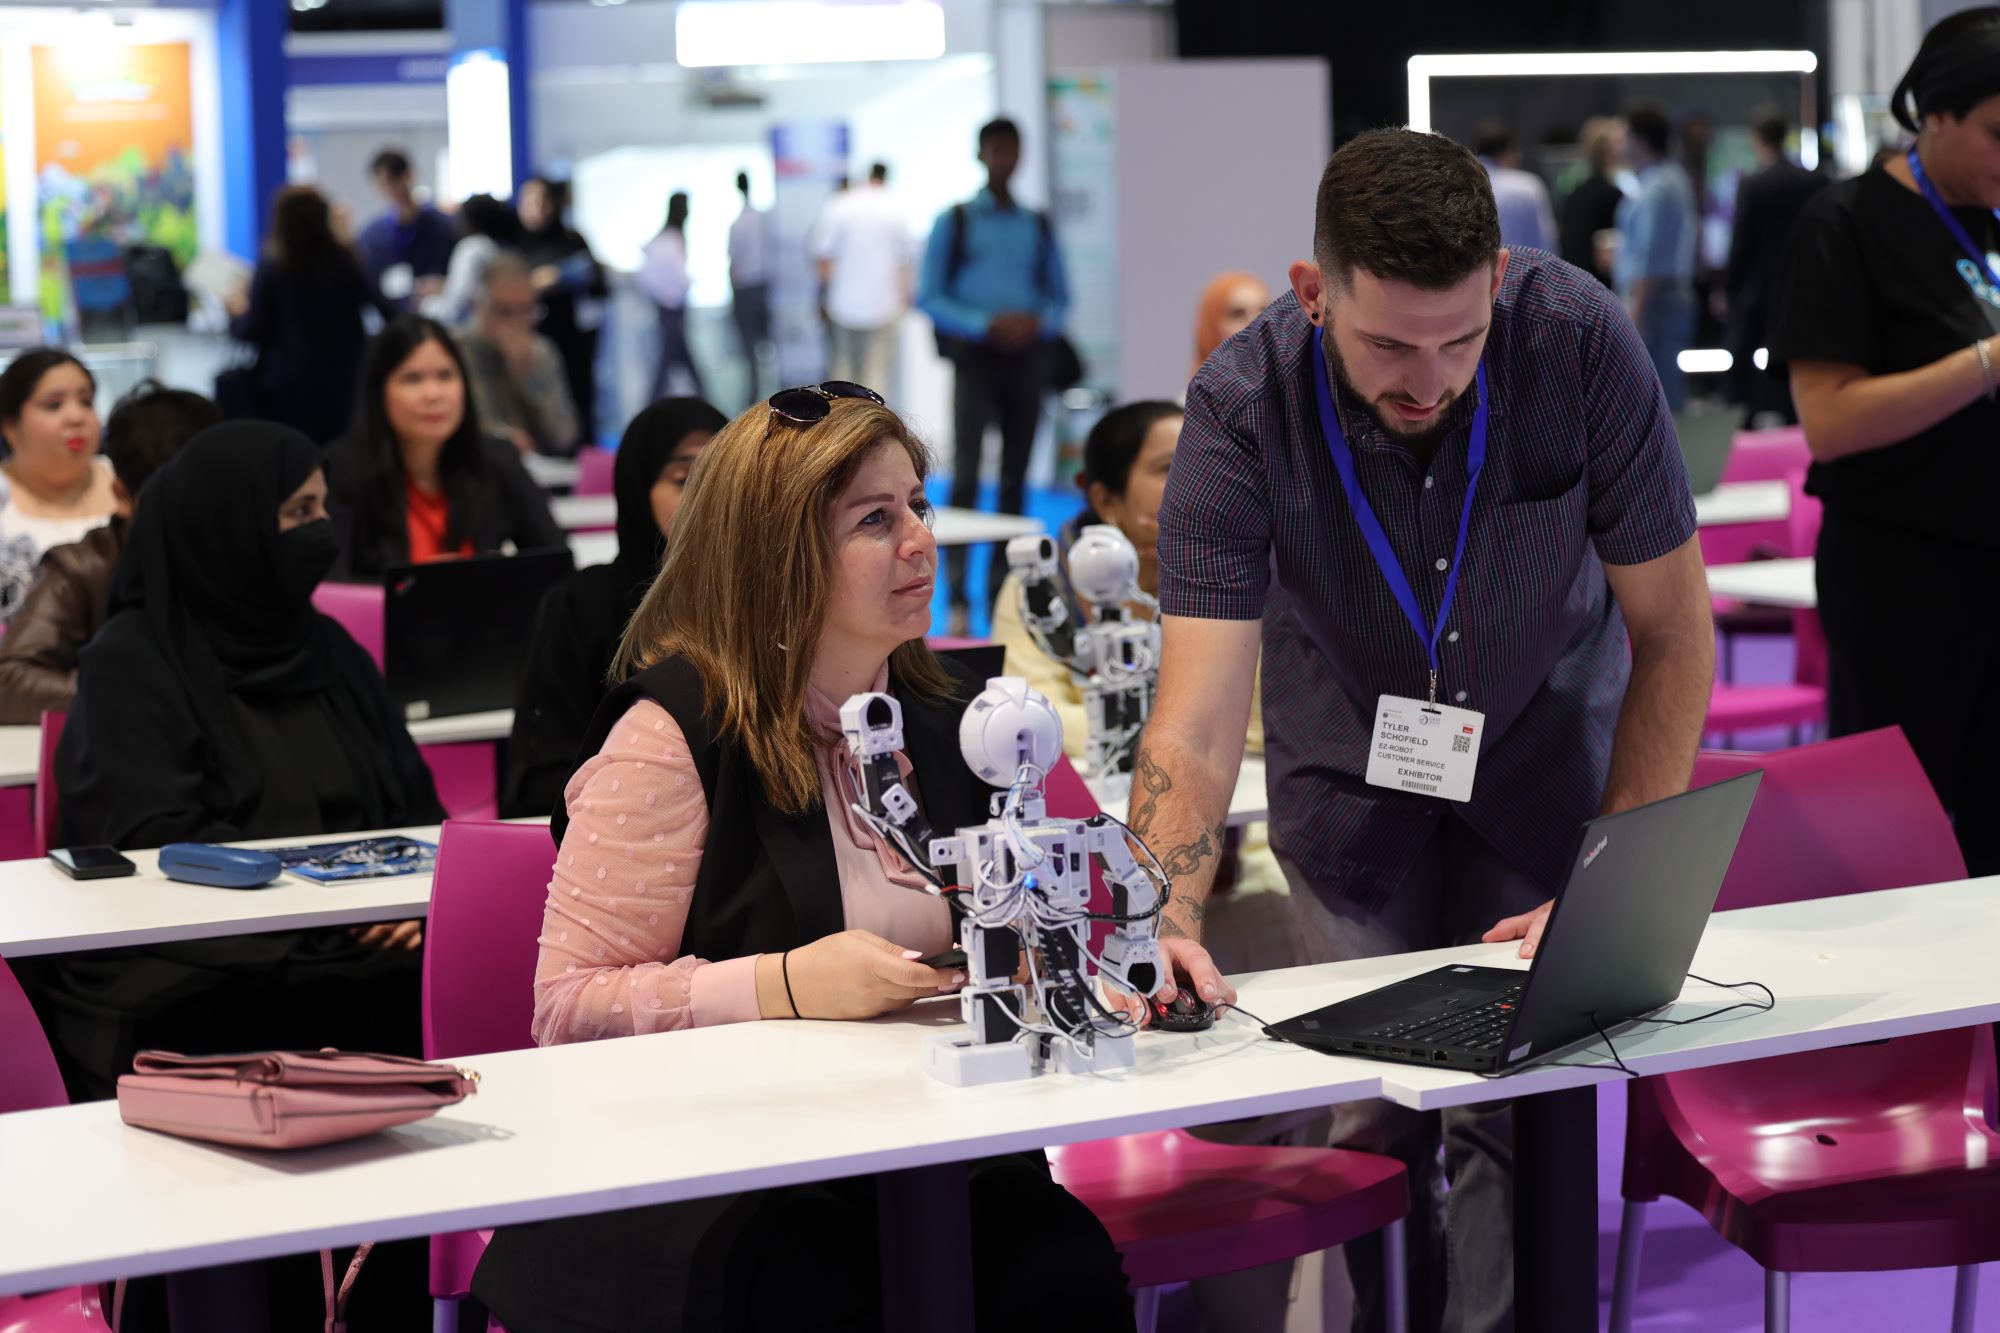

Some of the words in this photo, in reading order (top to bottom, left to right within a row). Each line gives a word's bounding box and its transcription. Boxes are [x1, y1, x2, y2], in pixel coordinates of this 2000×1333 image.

[1382, 722, 1410, 732] TYLER
[1381, 732, 1429, 746] SCHOFIELD
[1379, 743, 1414, 754] EZ-ROBOT
[1377, 752, 1416, 764] CUSTOMER
[1416, 758, 1446, 769] SERVICE
[1397, 768, 1443, 782] EXHIBITOR
